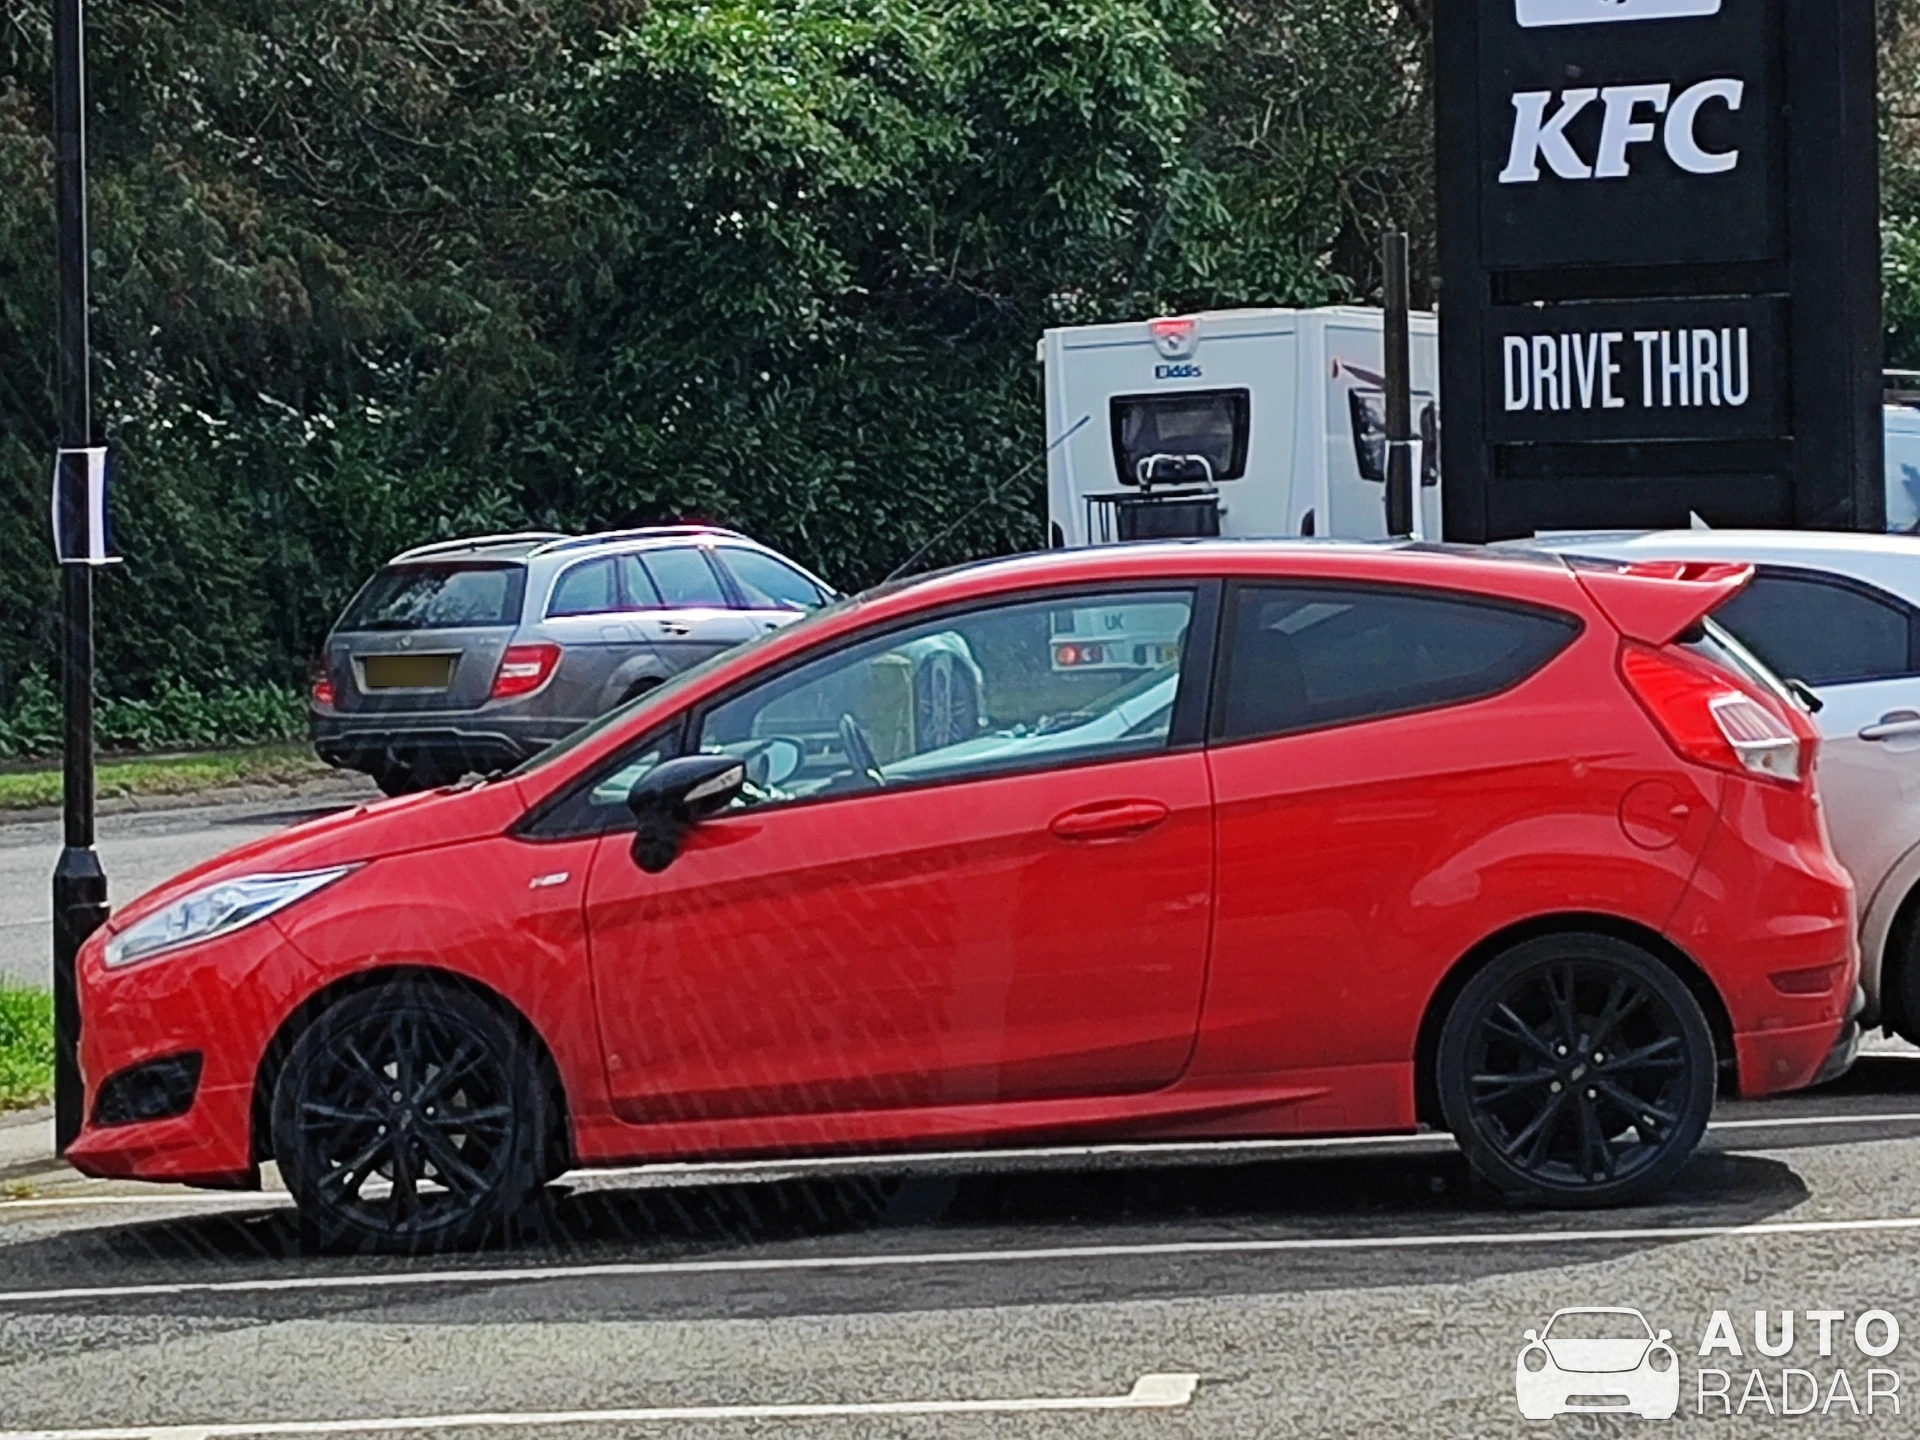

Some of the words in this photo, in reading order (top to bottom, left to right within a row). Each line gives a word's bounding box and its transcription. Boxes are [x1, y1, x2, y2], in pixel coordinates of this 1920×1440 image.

[1499, 79, 1744, 183] KFC
[1503, 331, 1625, 411] DRIVE
[1633, 328, 1749, 407] THRU
[1104, 613, 1124, 631] UK
